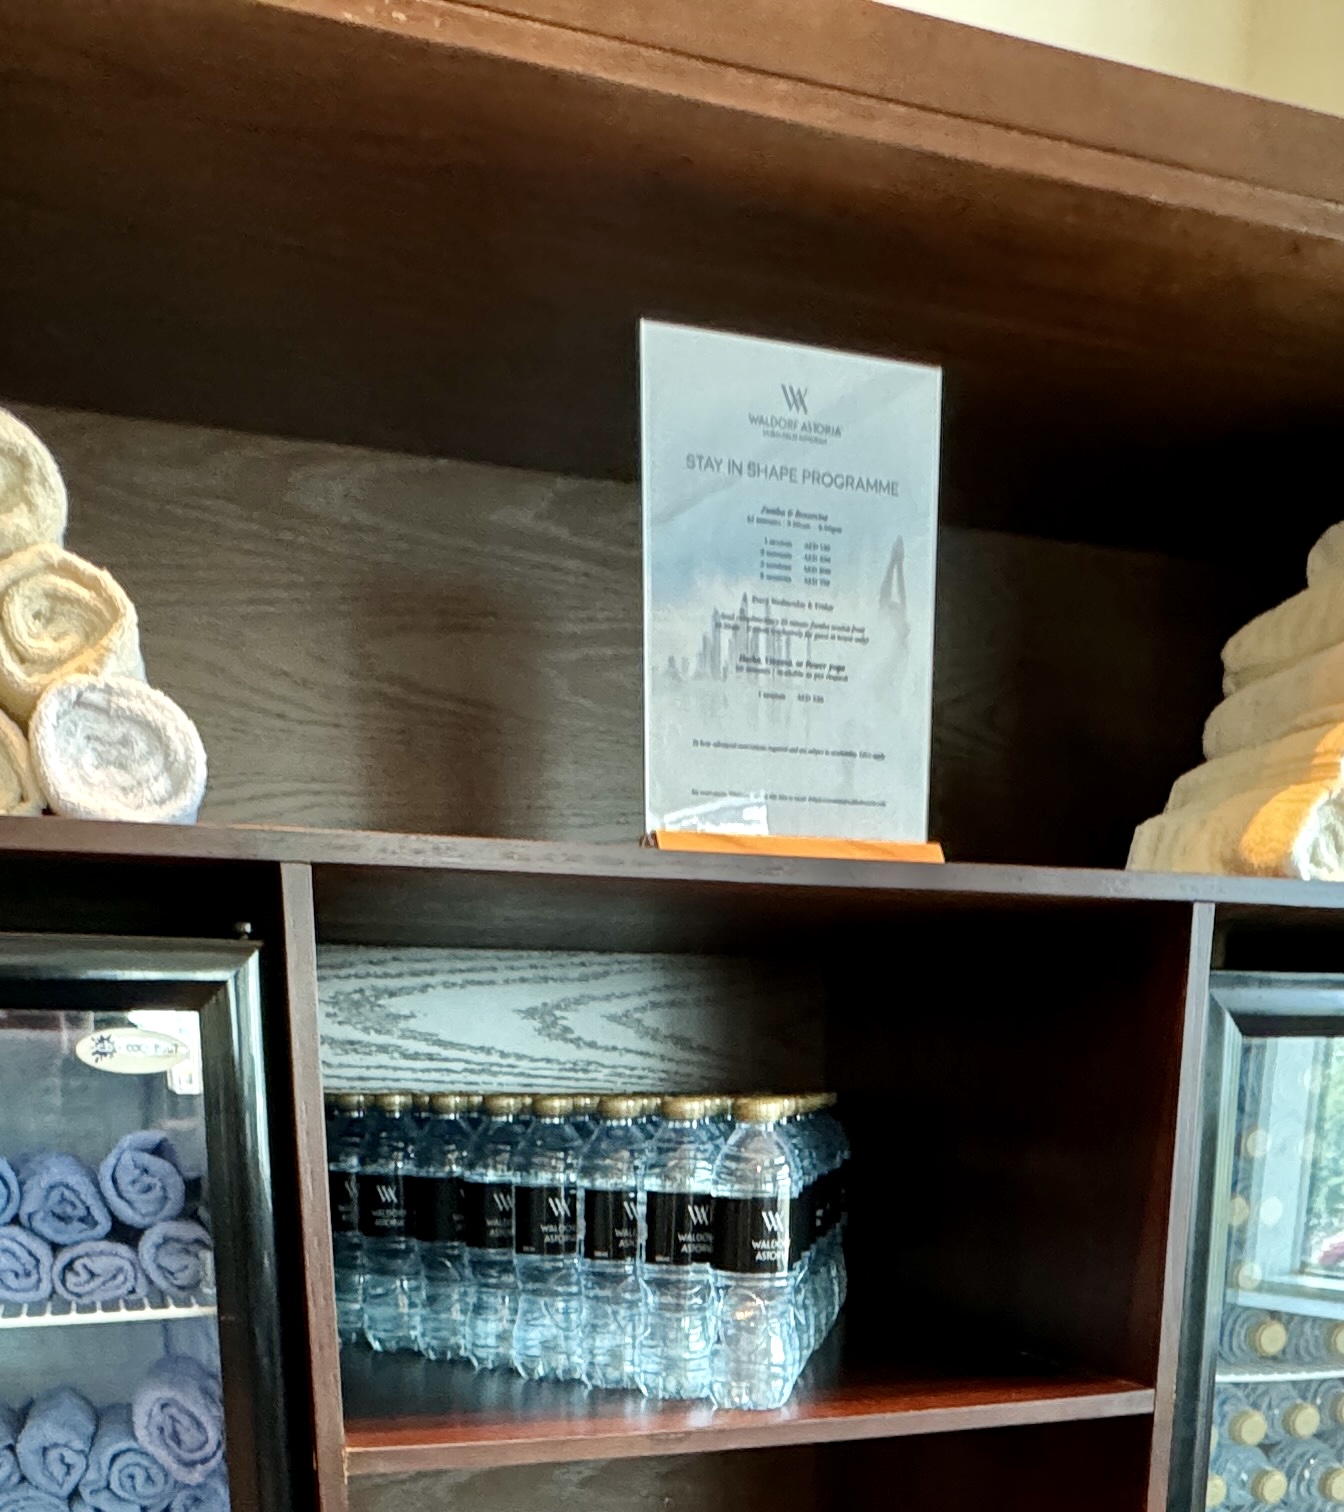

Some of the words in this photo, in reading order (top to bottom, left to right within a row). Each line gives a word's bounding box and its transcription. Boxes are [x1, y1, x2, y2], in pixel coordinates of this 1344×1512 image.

[748, 412, 798, 431] WALDORF
[800, 420, 842, 438] ASTORIA
[685, 452, 723, 474] STAY
[727, 458, 743, 477] IN
[747, 460, 798, 485] SHAPE
[801, 468, 899, 498] PROGRAMME
